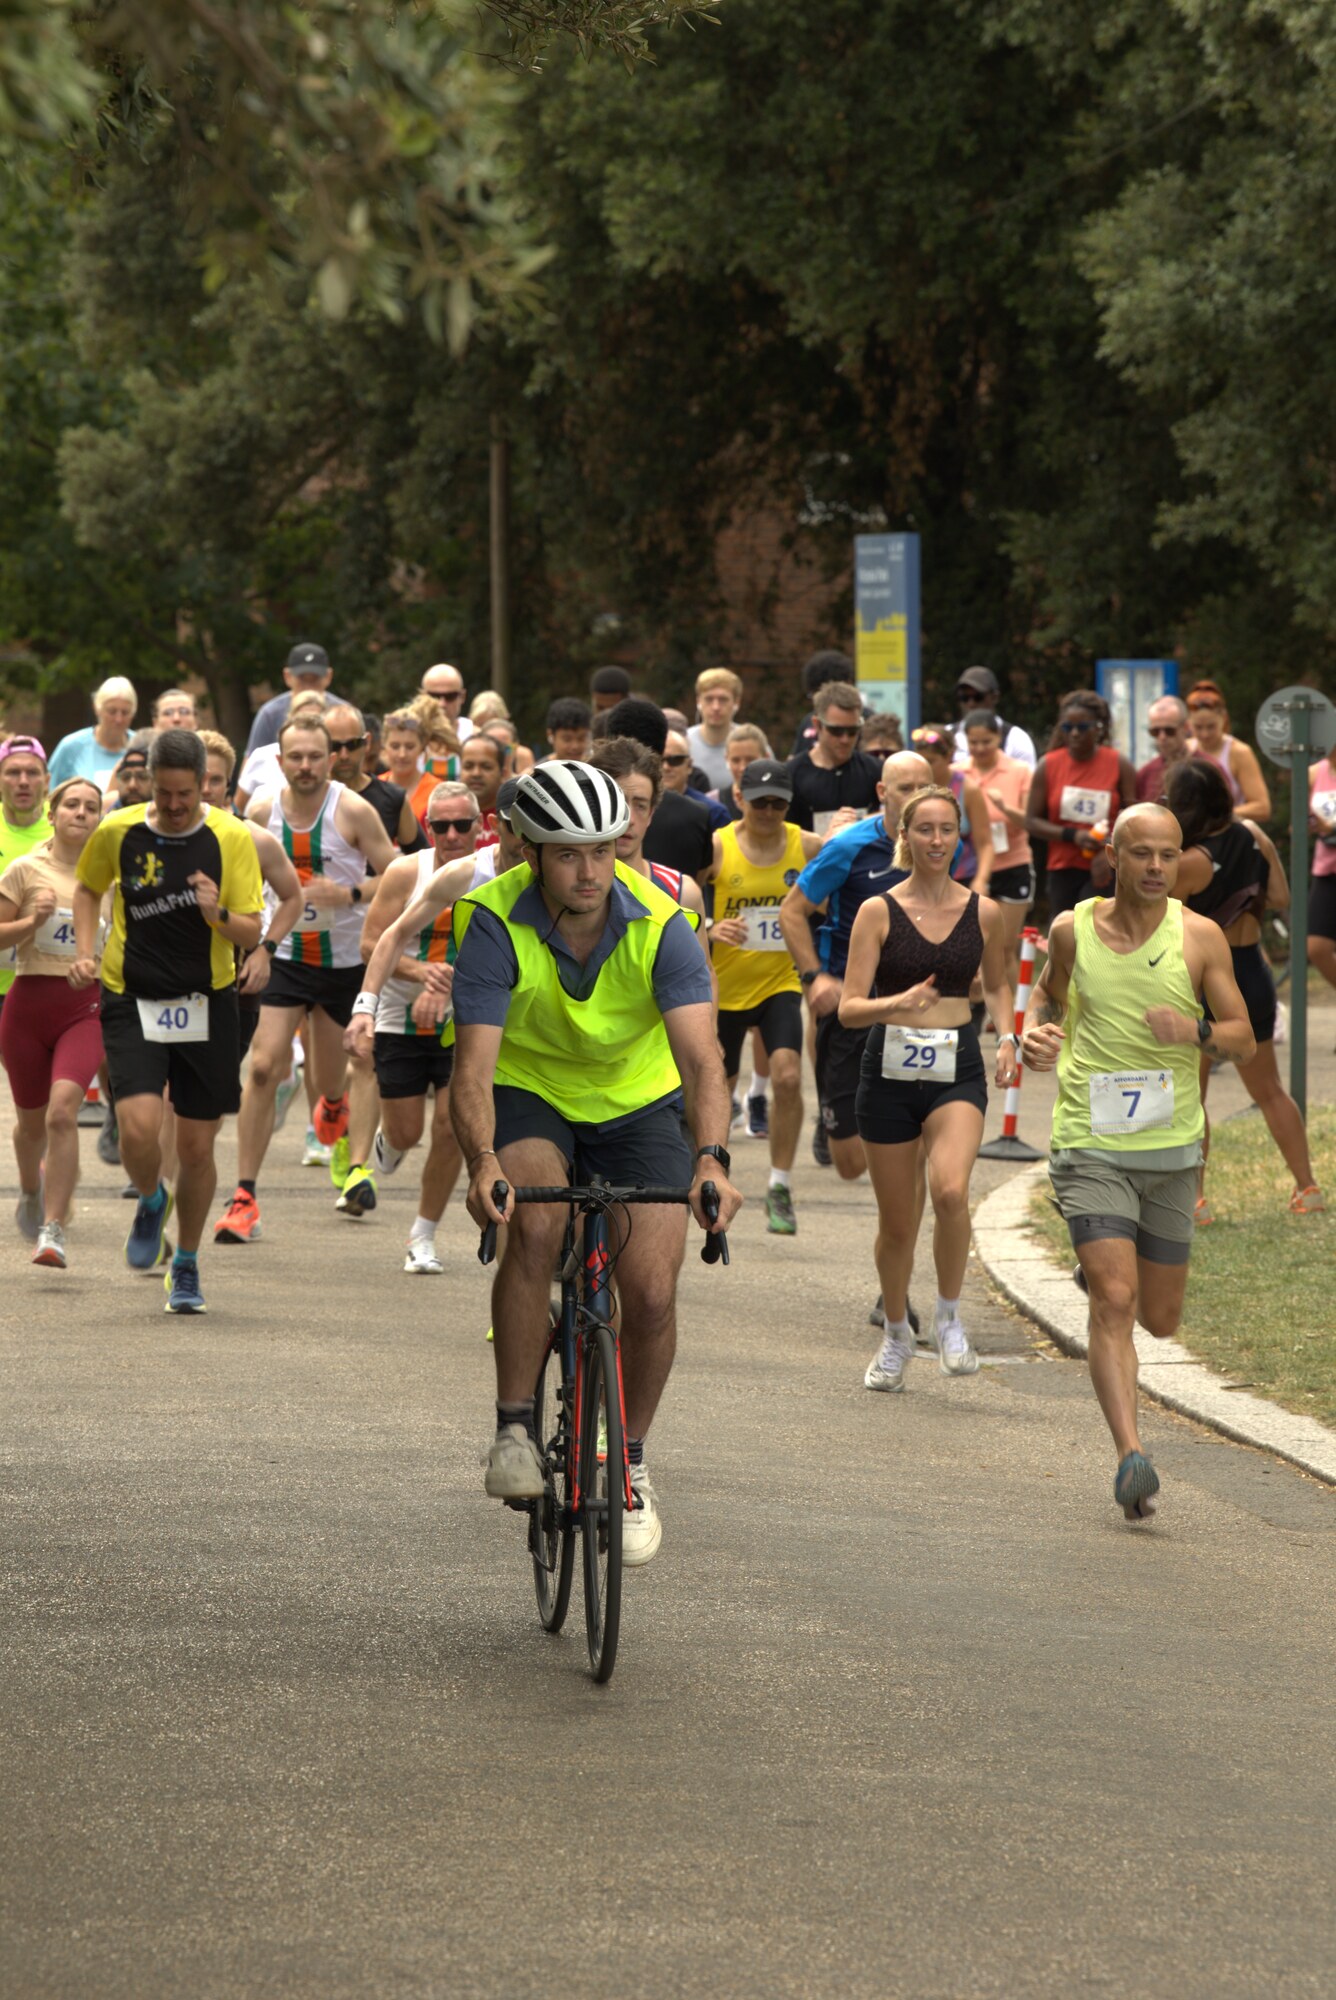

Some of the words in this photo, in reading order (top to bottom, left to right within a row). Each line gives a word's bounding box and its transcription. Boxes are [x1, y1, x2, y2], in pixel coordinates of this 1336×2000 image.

[1073, 799, 1096, 816] 43
[757, 920, 783, 940] 18
[157, 1007, 188, 1030] 40
[902, 1044, 936, 1069] 29
[1122, 1090, 1141, 1118] 7
